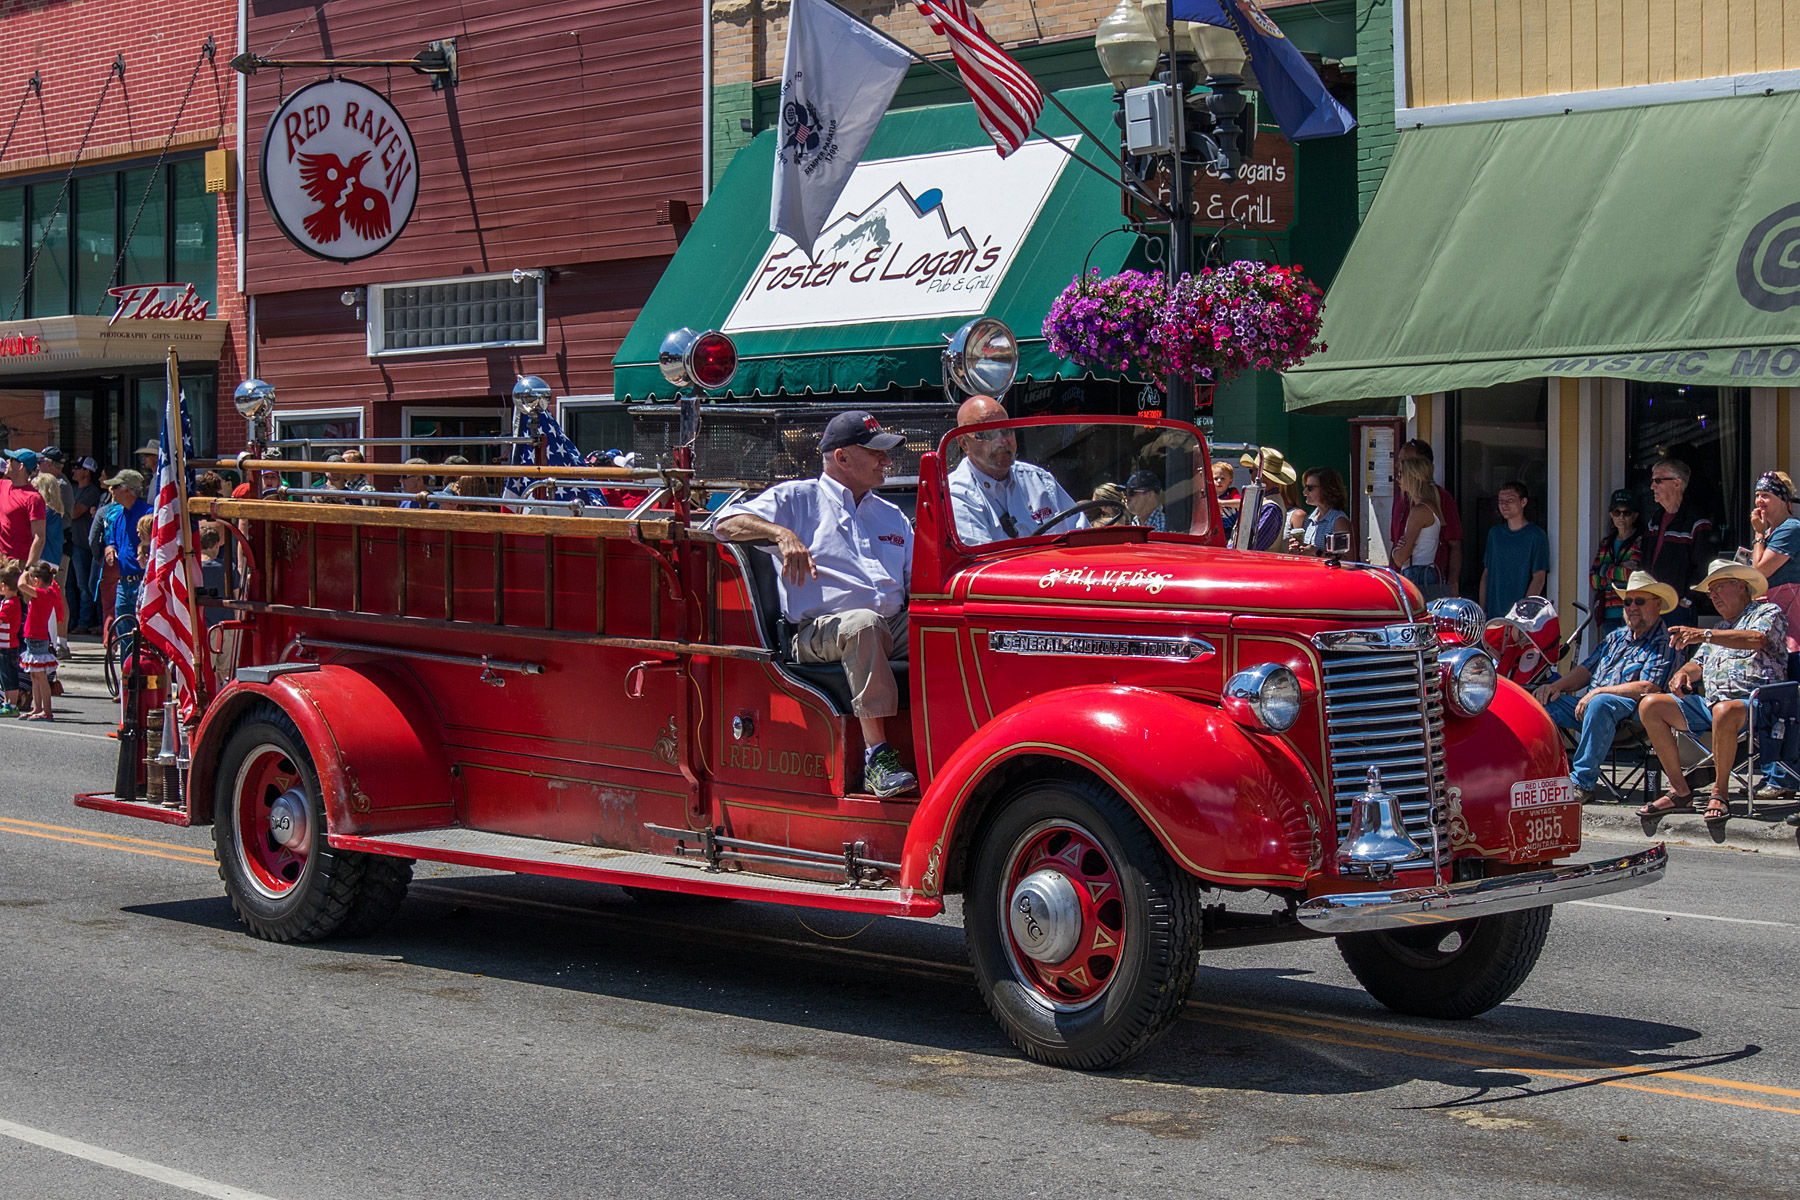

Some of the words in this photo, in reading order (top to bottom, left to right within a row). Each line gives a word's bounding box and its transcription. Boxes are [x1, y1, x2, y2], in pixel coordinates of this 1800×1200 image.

[284, 104, 331, 165] RED
[343, 101, 412, 205] RAVEN
[804, 152, 825, 175] SEMPER
[823, 119, 837, 152] PARATUS
[825, 143, 839, 165] 1790
[1238, 157, 1286, 185] ogan's
[1206, 194, 1224, 219] &
[1230, 193, 1275, 229] Grill
[745, 249, 849, 301] Foster
[849, 247, 883, 283] &
[879, 234, 1002, 286] Logan's
[926, 278, 951, 293] Pub
[952, 277, 965, 291] &
[965, 273, 994, 291] Grill
[108, 282, 211, 327] Flash's
[99, 331, 148, 340] PHOTOGRAPHY
[151, 332, 171, 340] GIFTS
[173, 333, 203, 341] GALLERY
[1542, 351, 1710, 376] MYSTIC
[1024, 386, 1055, 405] LIGHT
[1002, 635, 1064, 651] GENERAL
[1072, 639, 1129, 655] MOTORS
[1139, 641, 1186, 657] TRUCK
[730, 744, 763, 771] RED
[767, 749, 825, 779] LODGE
[1514, 789, 1538, 807] FIRE
[1540, 786, 1570, 803] DEPT.
[1537, 780, 1558, 789] LODGE
[1529, 807, 1557, 817] VINTAGE
[1525, 815, 1563, 843] 3855
[1526, 839, 1560, 850] MONTANA
[1018, 895, 1044, 942] GMC
